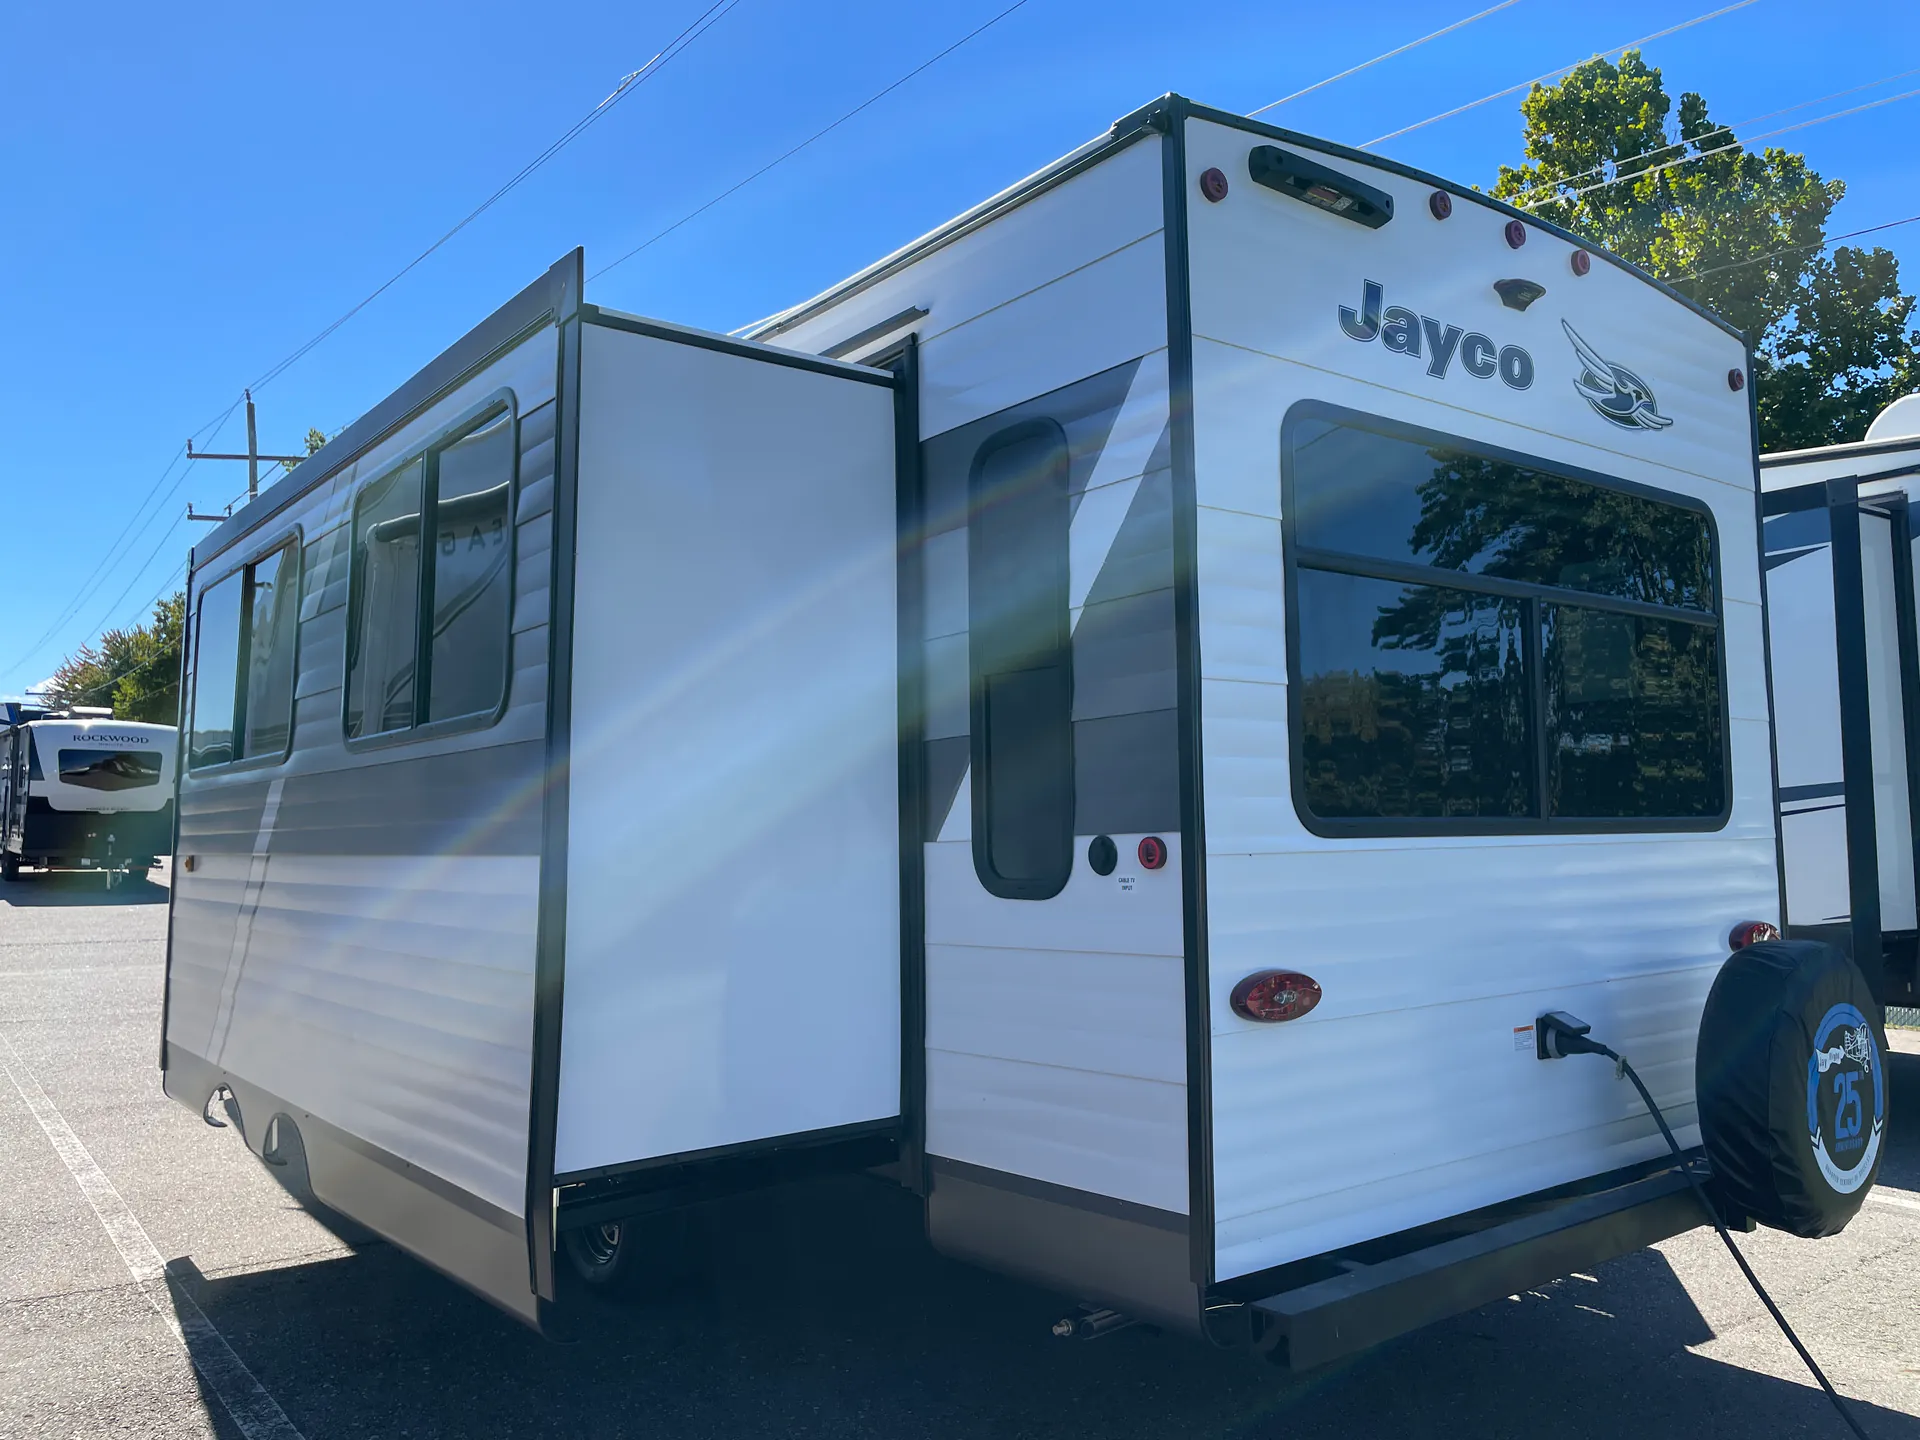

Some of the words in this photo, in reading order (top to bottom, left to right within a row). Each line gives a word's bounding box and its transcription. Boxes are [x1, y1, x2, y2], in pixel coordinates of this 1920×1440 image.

[1338, 278, 1535, 391] Jayco
[73, 734, 149, 744] ROCKWOOD
[1833, 1071, 1862, 1140] 25
